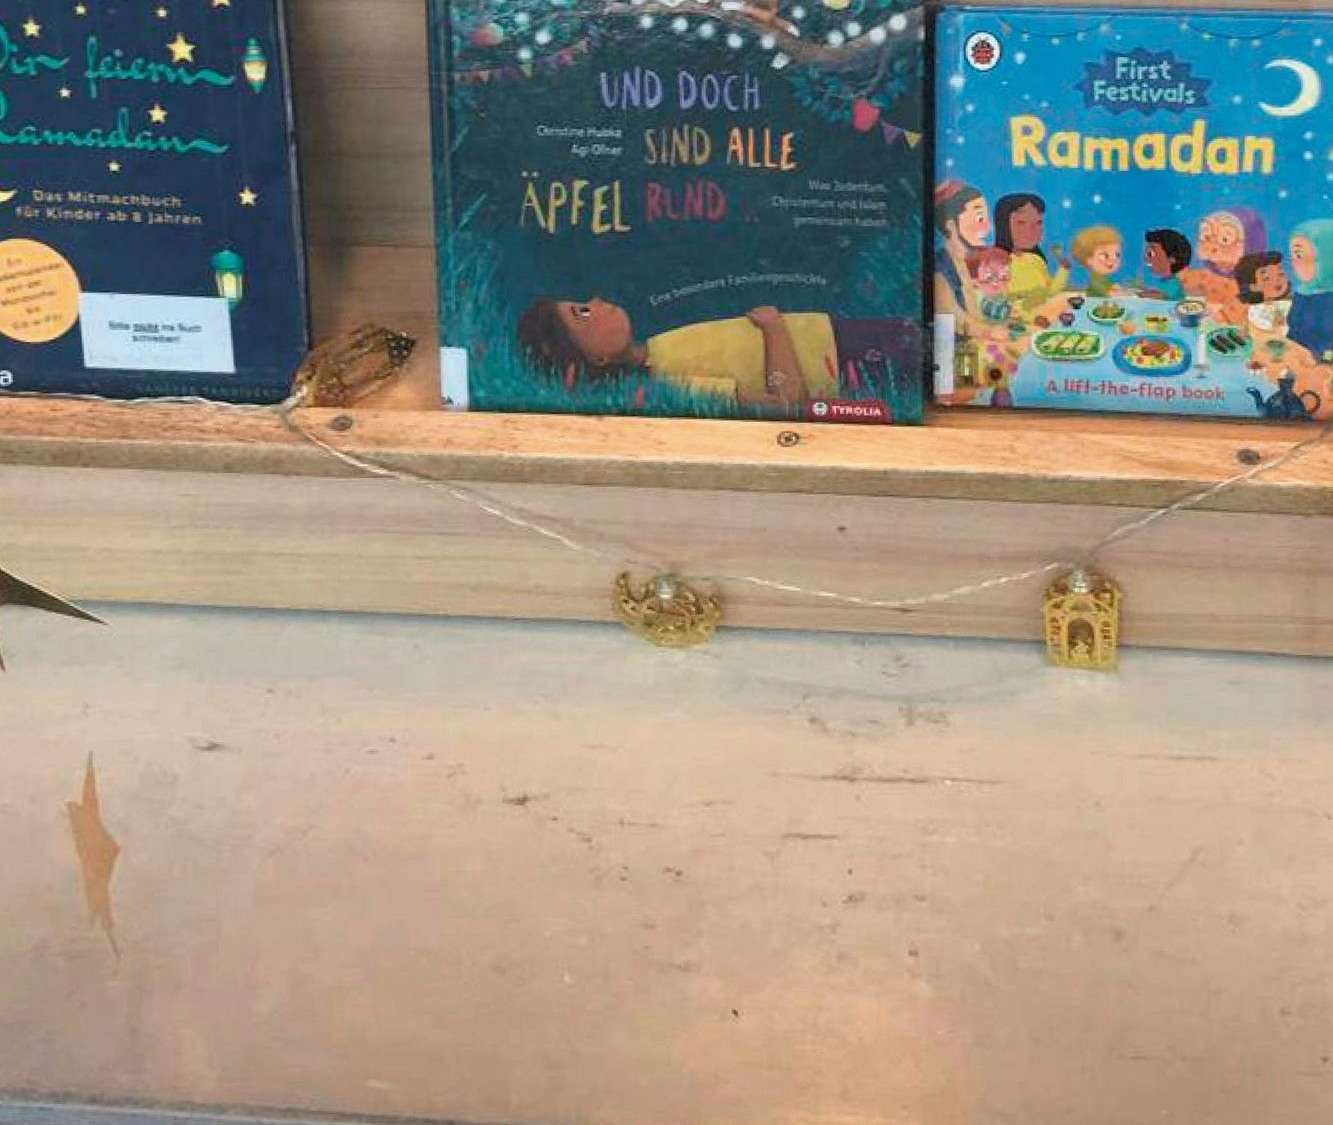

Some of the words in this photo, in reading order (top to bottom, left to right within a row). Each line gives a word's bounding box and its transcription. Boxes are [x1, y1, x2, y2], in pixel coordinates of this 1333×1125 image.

[0, 25, 70, 76] ir
[85, 35, 235, 99] feiern
[1115, 58, 1172, 81] First
[600, 66, 663, 109] UND
[678, 72, 761, 110] DOCH
[1093, 80, 1197, 106] Festivals
[645, 125, 712, 166] SIND
[727, 127, 798, 172] ALLE
[1009, 115, 1275, 174] Ramadan
[33, 190, 63, 203] Das
[68, 191, 183, 208] Mitmachbuch
[519, 171, 631, 235] ÄPFEL
[646, 180, 728, 223] RUND
[15, 206, 41, 219] für
[46, 208, 101, 221] Kinder
[107, 211, 128, 222] ab
[147, 212, 204, 225] Jahren
[1046, 379, 1060, 394] A
[1181, 382, 1227, 401] book
[832, 405, 882, 416] TYROLIA
